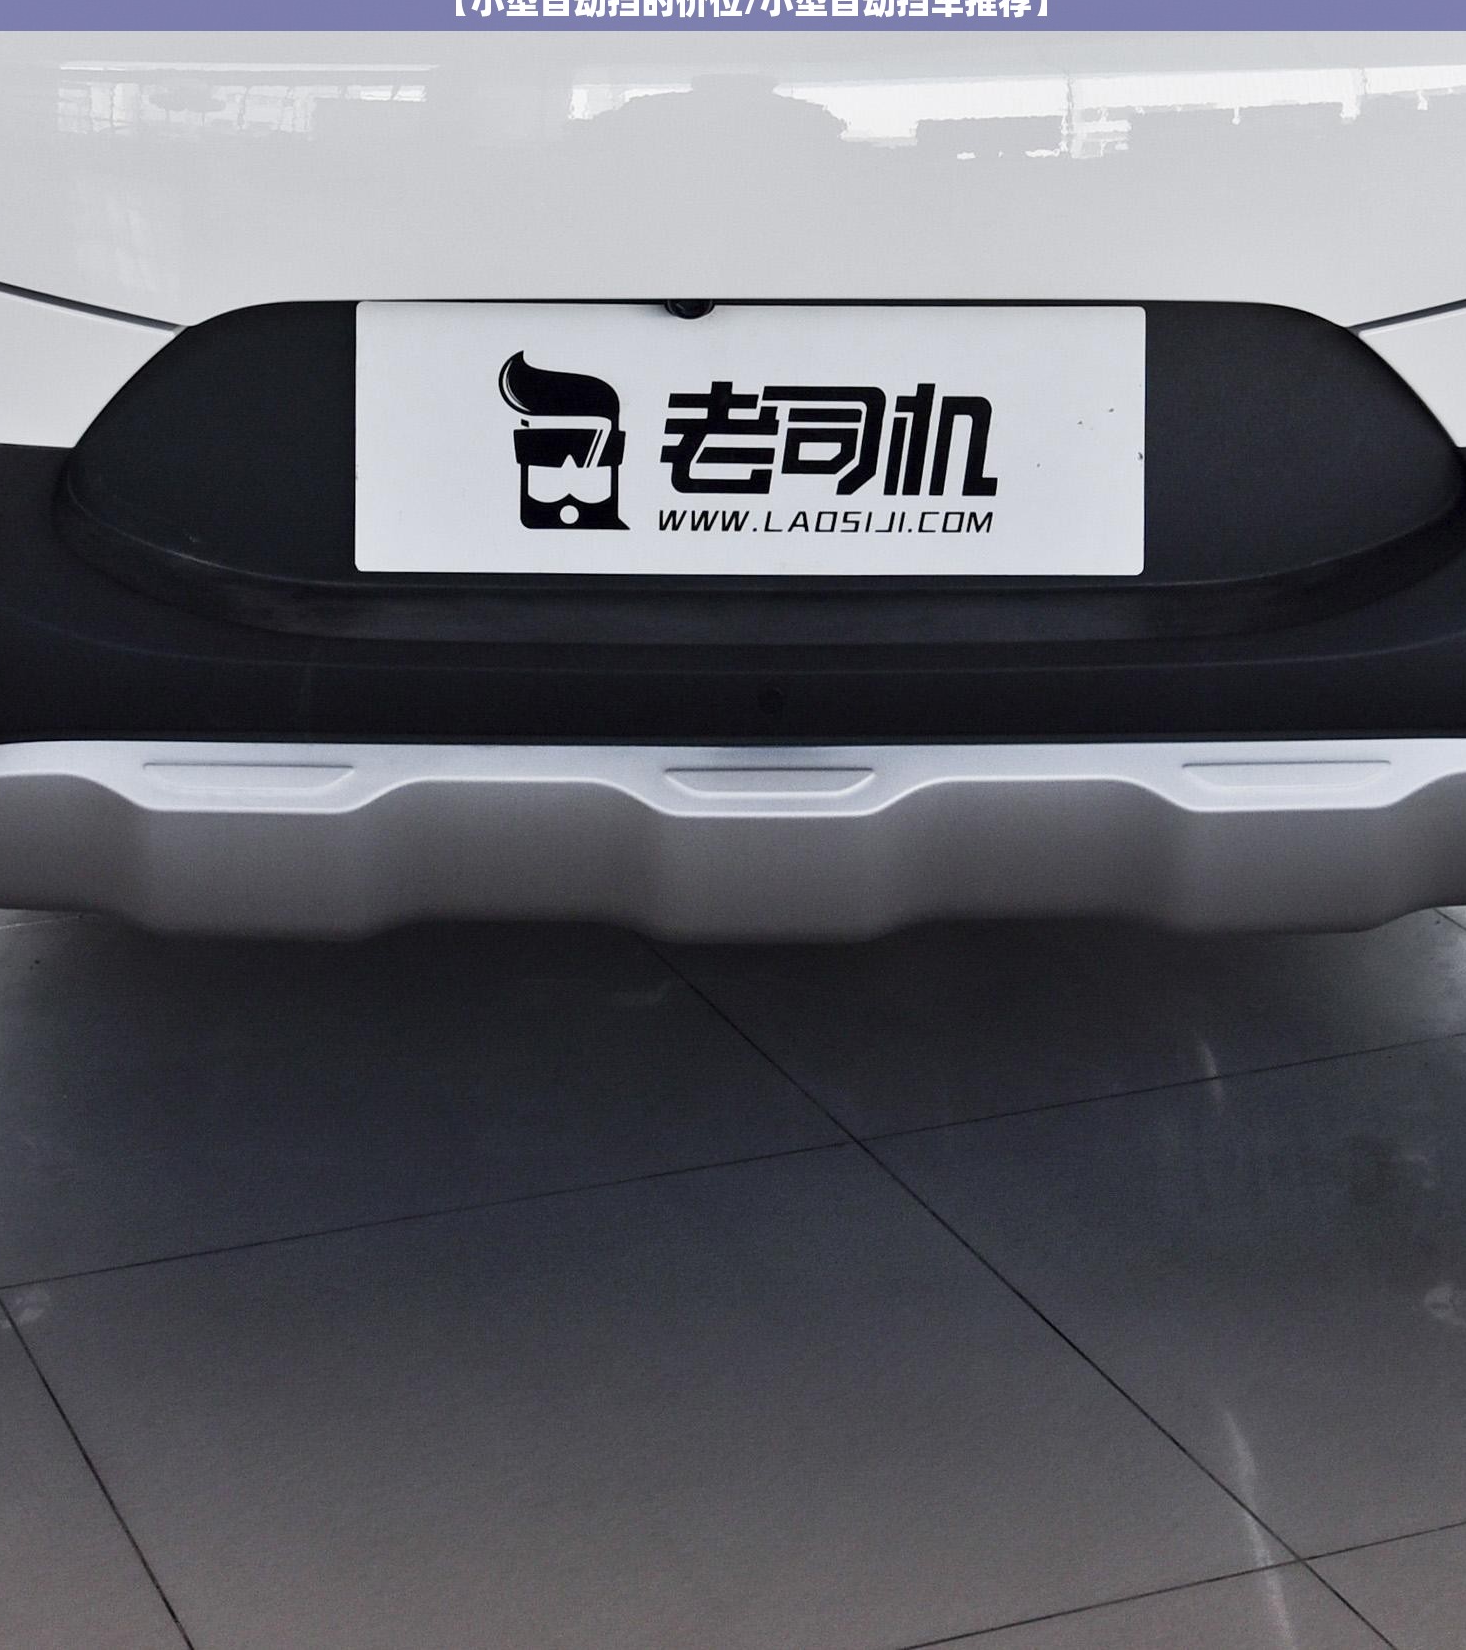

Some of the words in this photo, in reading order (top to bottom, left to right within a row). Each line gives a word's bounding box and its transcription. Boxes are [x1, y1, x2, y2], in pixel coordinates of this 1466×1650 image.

[660, 381, 998, 497] 老司机
[659, 509, 994, 533] WWW.LAOSIJI.COM
